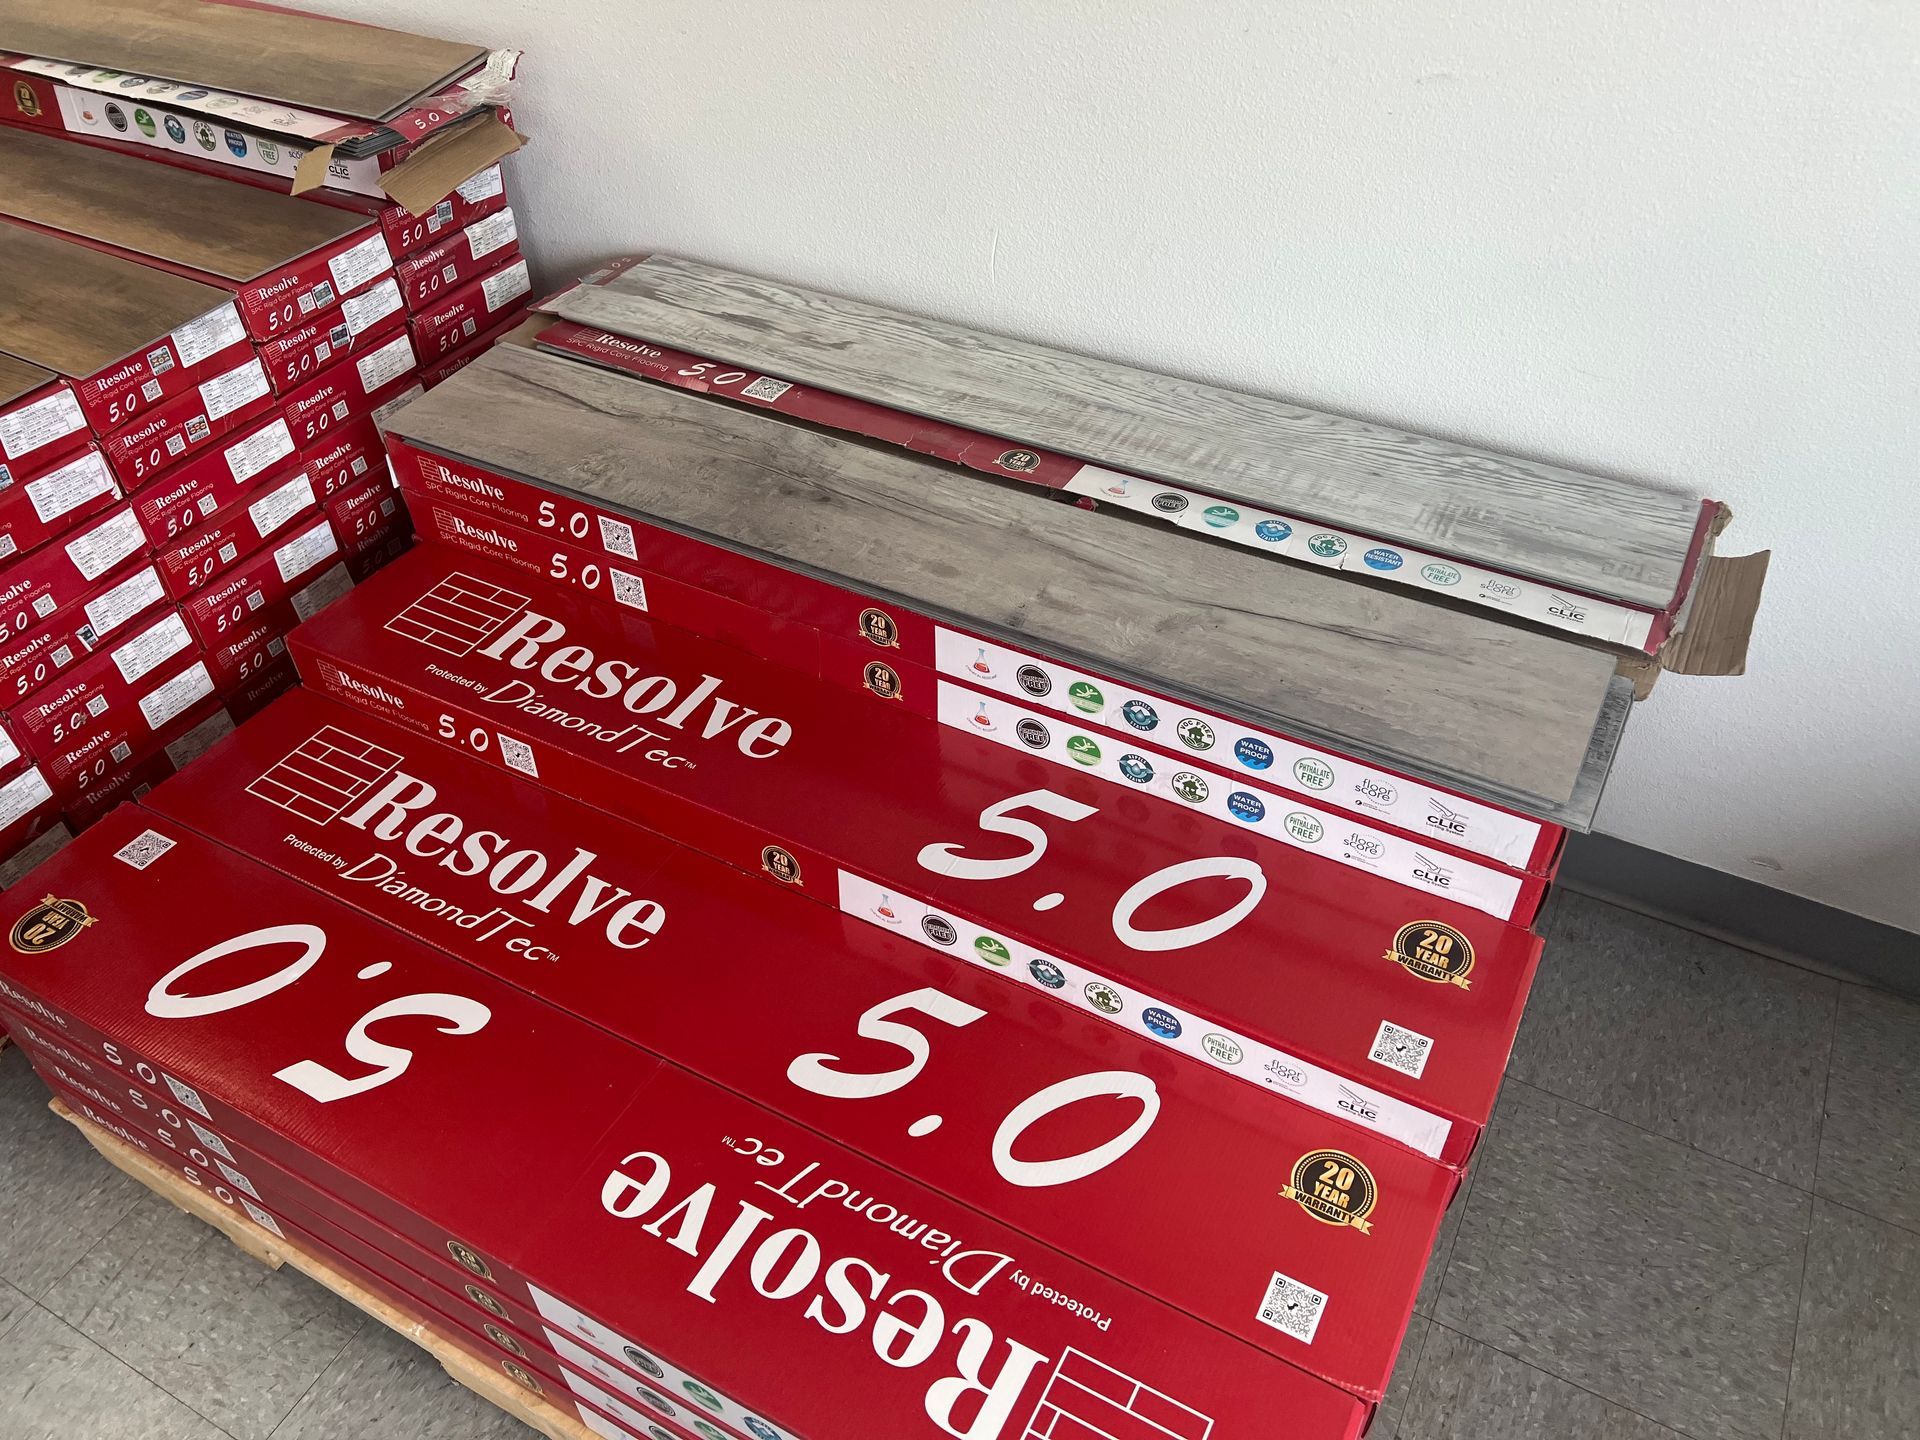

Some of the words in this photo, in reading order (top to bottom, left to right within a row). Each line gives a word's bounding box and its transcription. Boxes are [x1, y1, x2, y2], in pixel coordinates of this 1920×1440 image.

[415, 112, 440, 130] 5.0
[263, 150, 276, 160] FREE
[329, 166, 348, 176] CLIC
[402, 224, 422, 246] 5.0
[411, 248, 444, 270] Resolve
[258, 275, 299, 300] Resolve
[420, 274, 438, 298] 5.0
[269, 304, 292, 330] 5.0
[434, 303, 464, 325] Resolve
[278, 326, 316, 352] Resolve
[440, 328, 458, 351] 5.0
[595, 333, 662, 359] Resolve
[440, 356, 470, 379] Resolve
[566, 338, 583, 346] SPC
[586, 342, 609, 354] Rigid
[610, 349, 631, 360] Core
[631, 356, 670, 372] Flooring
[96, 361, 142, 391] Resolve
[678, 363, 746, 384] 5.0
[109, 393, 136, 422] 5.0
[298, 386, 334, 412] Resolve
[122, 417, 167, 448] Resolve
[306, 414, 328, 439] 5.0
[135, 449, 160, 478] 5.0
[315, 442, 352, 470] Resolve
[1013, 453, 1030, 462] 20
[155, 479, 198, 510] Resolve
[326, 470, 348, 495] 5.0
[438, 466, 504, 500] Resolve
[346, 484, 380, 510] Resolve
[426, 481, 442, 493] SPC
[445, 485, 467, 501] Rigid
[470, 495, 490, 508] Core
[492, 503, 529, 522] Flooring
[168, 508, 192, 538] 5.0
[356, 510, 377, 536] 5.0
[538, 501, 588, 538] 5.0
[178, 530, 222, 559] Resolve
[453, 516, 518, 552] Resolve
[1333, 534, 1345, 549] FREE
[440, 532, 458, 544] SPC
[459, 536, 482, 552] Rigid
[483, 546, 504, 560] Core
[504, 554, 542, 573] Flooring
[1366, 554, 1402, 566] RESISTANT
[1373, 550, 1399, 560] WATER
[188, 558, 214, 586] 5.0
[550, 553, 600, 590] 5.0
[1427, 567, 1457, 580] PHTHALATE
[1428, 573, 1450, 584] FREE
[0, 580, 32, 604] solve
[207, 577, 248, 606] Resolve
[1480, 583, 1514, 596] score
[1488, 579, 1516, 594] floor
[218, 605, 242, 632] 5.0
[870, 614, 886, 629] 20
[1548, 606, 1585, 620] CLIC
[229, 626, 268, 655] Resolve
[870, 626, 888, 638] YEAR
[2, 633, 52, 668] Resolve
[17, 663, 46, 695] 5.0
[240, 652, 262, 680] 5.0
[424, 663, 472, 690] Protected
[472, 680, 488, 694] by
[875, 668, 890, 682] 20
[338, 670, 404, 709] Resolve
[477, 610, 792, 760] Resolve
[875, 678, 892, 690] YEAR
[38, 682, 86, 717] Resolve
[326, 683, 343, 696] SPC
[344, 690, 368, 707] Rigid
[370, 700, 390, 714] Core
[392, 708, 430, 731] Flooring
[438, 714, 488, 752] 5.0
[1180, 720, 1194, 730] VOC
[1196, 720, 1213, 739] FREE
[65, 730, 112, 764] Resolve
[1240, 740, 1270, 754] WATER
[1240, 748, 1268, 760] PROOF
[79, 759, 104, 789] 5.0
[1175, 774, 1188, 784] VOC
[1191, 775, 1207, 792] FREE
[1298, 763, 1330, 780] PHTHALATE
[1301, 773, 1326, 786] FREE
[86, 770, 132, 804] Resolve
[1355, 784, 1390, 802] score
[1362, 778, 1393, 796] floor
[1232, 801, 1260, 814] PROOF
[1233, 794, 1262, 808] WATER
[1289, 816, 1320, 833] PHTHALATE
[1291, 827, 1314, 840] FREE
[1427, 815, 1466, 833] CLIC
[283, 832, 333, 864] Protected
[332, 854, 349, 870] by
[1343, 838, 1378, 856] score
[1350, 832, 1380, 849] floor
[339, 770, 666, 950] Resolve
[772, 852, 788, 867] 20
[773, 861, 790, 875] YEAR
[916, 789, 1268, 952] 5.0
[1413, 869, 1450, 886] CLIC
[42, 911, 70, 930] YEAR
[24, 923, 57, 945] 20
[1420, 929, 1453, 955] 20
[1398, 954, 1455, 981] WARRANTY
[1415, 946, 1450, 969] YEAR
[0, 980, 68, 1028] Resolve
[144, 924, 492, 1104] 5.0
[1148, 1010, 1178, 1026] WATER
[1148, 1016, 1176, 1031] PROOF
[24, 1026, 94, 1074] Resolve
[1207, 1037, 1239, 1056] PHTHALATE
[1210, 1047, 1234, 1062] FREE
[103, 1042, 156, 1084] 5.0
[1264, 1064, 1300, 1083] score
[1272, 1059, 1302, 1077] floor
[54, 1065, 124, 1114] Resolve
[787, 986, 1161, 1187] 5.0
[128, 1088, 182, 1129] 5.0
[1338, 1100, 1376, 1119] CLIC
[82, 1104, 150, 1150] Resolve
[158, 1128, 209, 1168] 5.0
[184, 1166, 234, 1204] 5.0
[1319, 1160, 1355, 1191] 20
[1294, 1190, 1355, 1224] WARRANTY
[1313, 1180, 1350, 1208] YEAR
[1007, 1268, 1031, 1288] by
[600, 1151, 1050, 1440] Resolve
[1030, 1280, 1113, 1333] Protected
